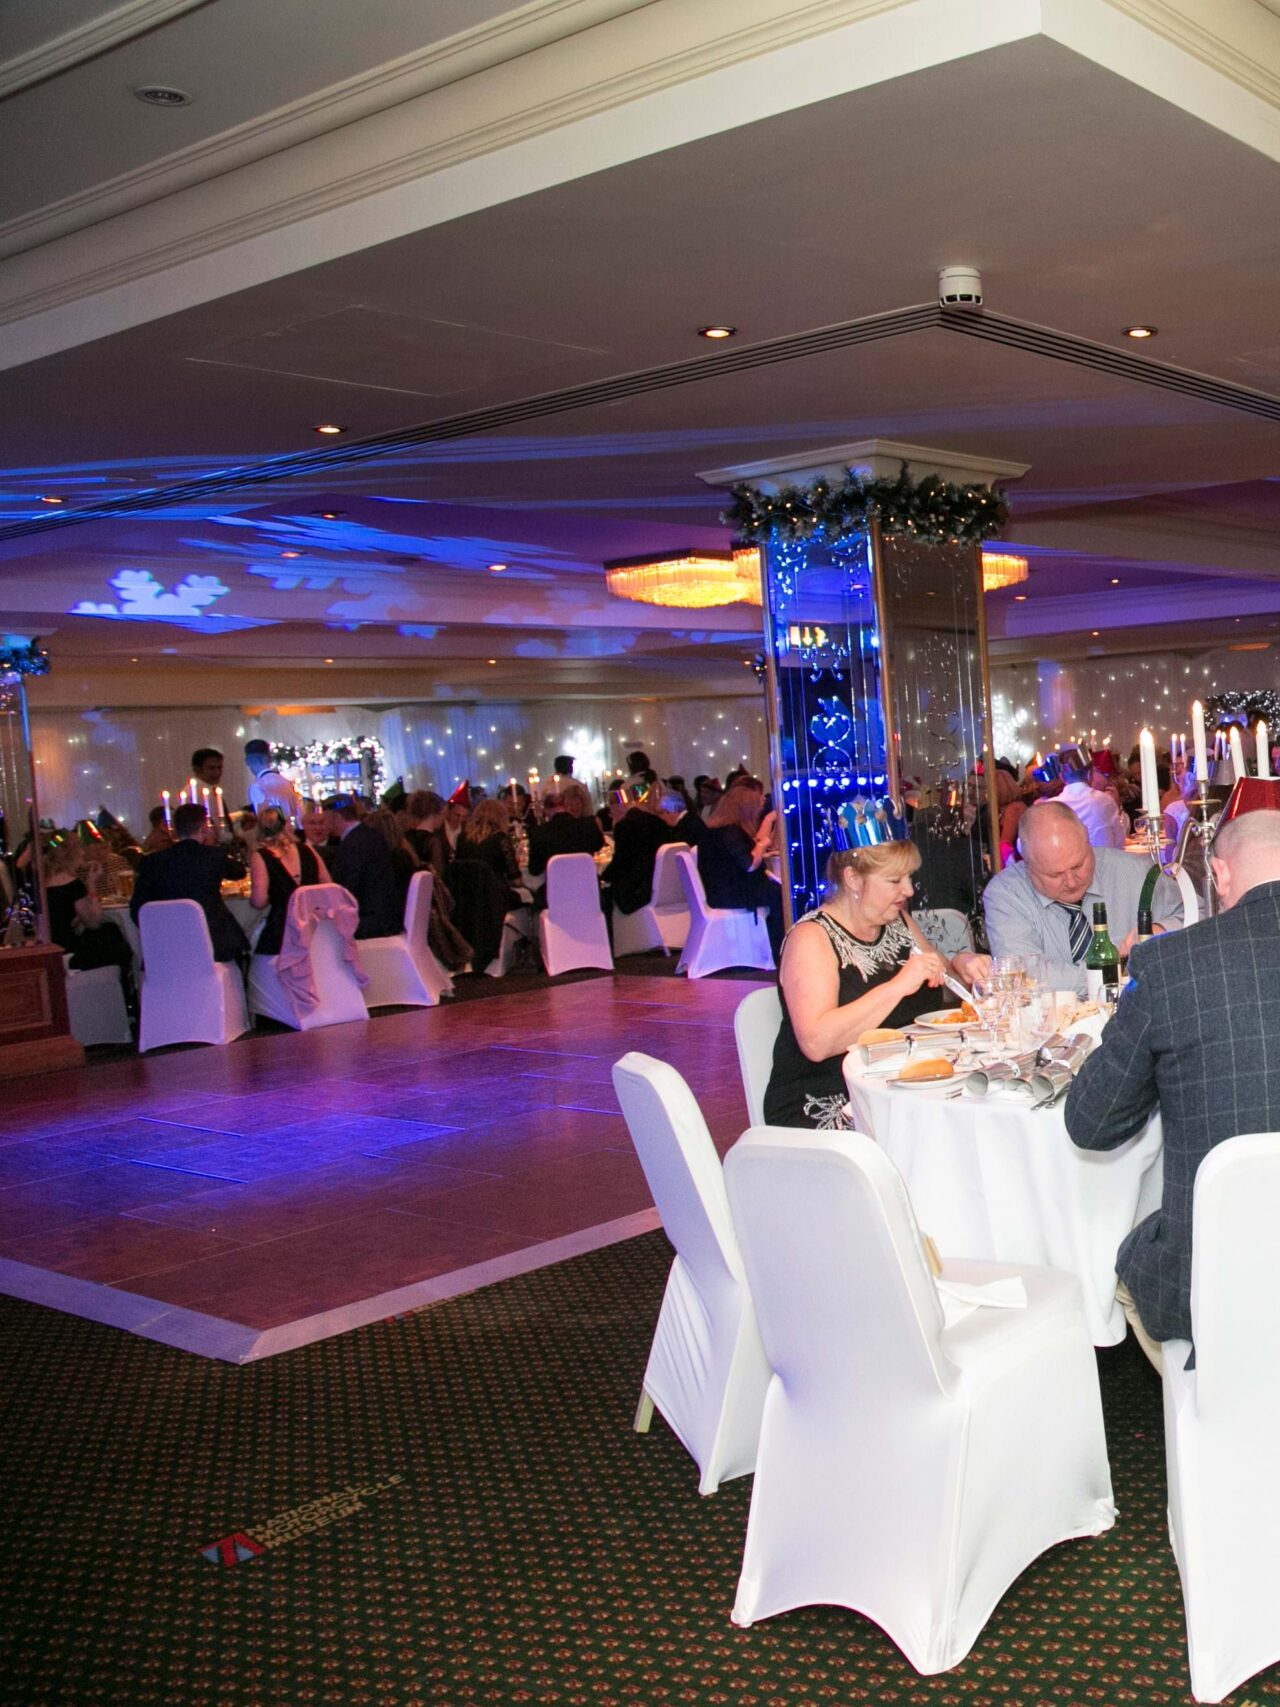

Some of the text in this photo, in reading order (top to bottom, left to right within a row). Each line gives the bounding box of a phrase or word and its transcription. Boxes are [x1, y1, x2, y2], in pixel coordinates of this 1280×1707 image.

[245, 1485, 362, 1538] NATIONAL
[256, 1474, 405, 1543] MOTORCYCLE
[263, 1502, 367, 1549] MUSEUM
